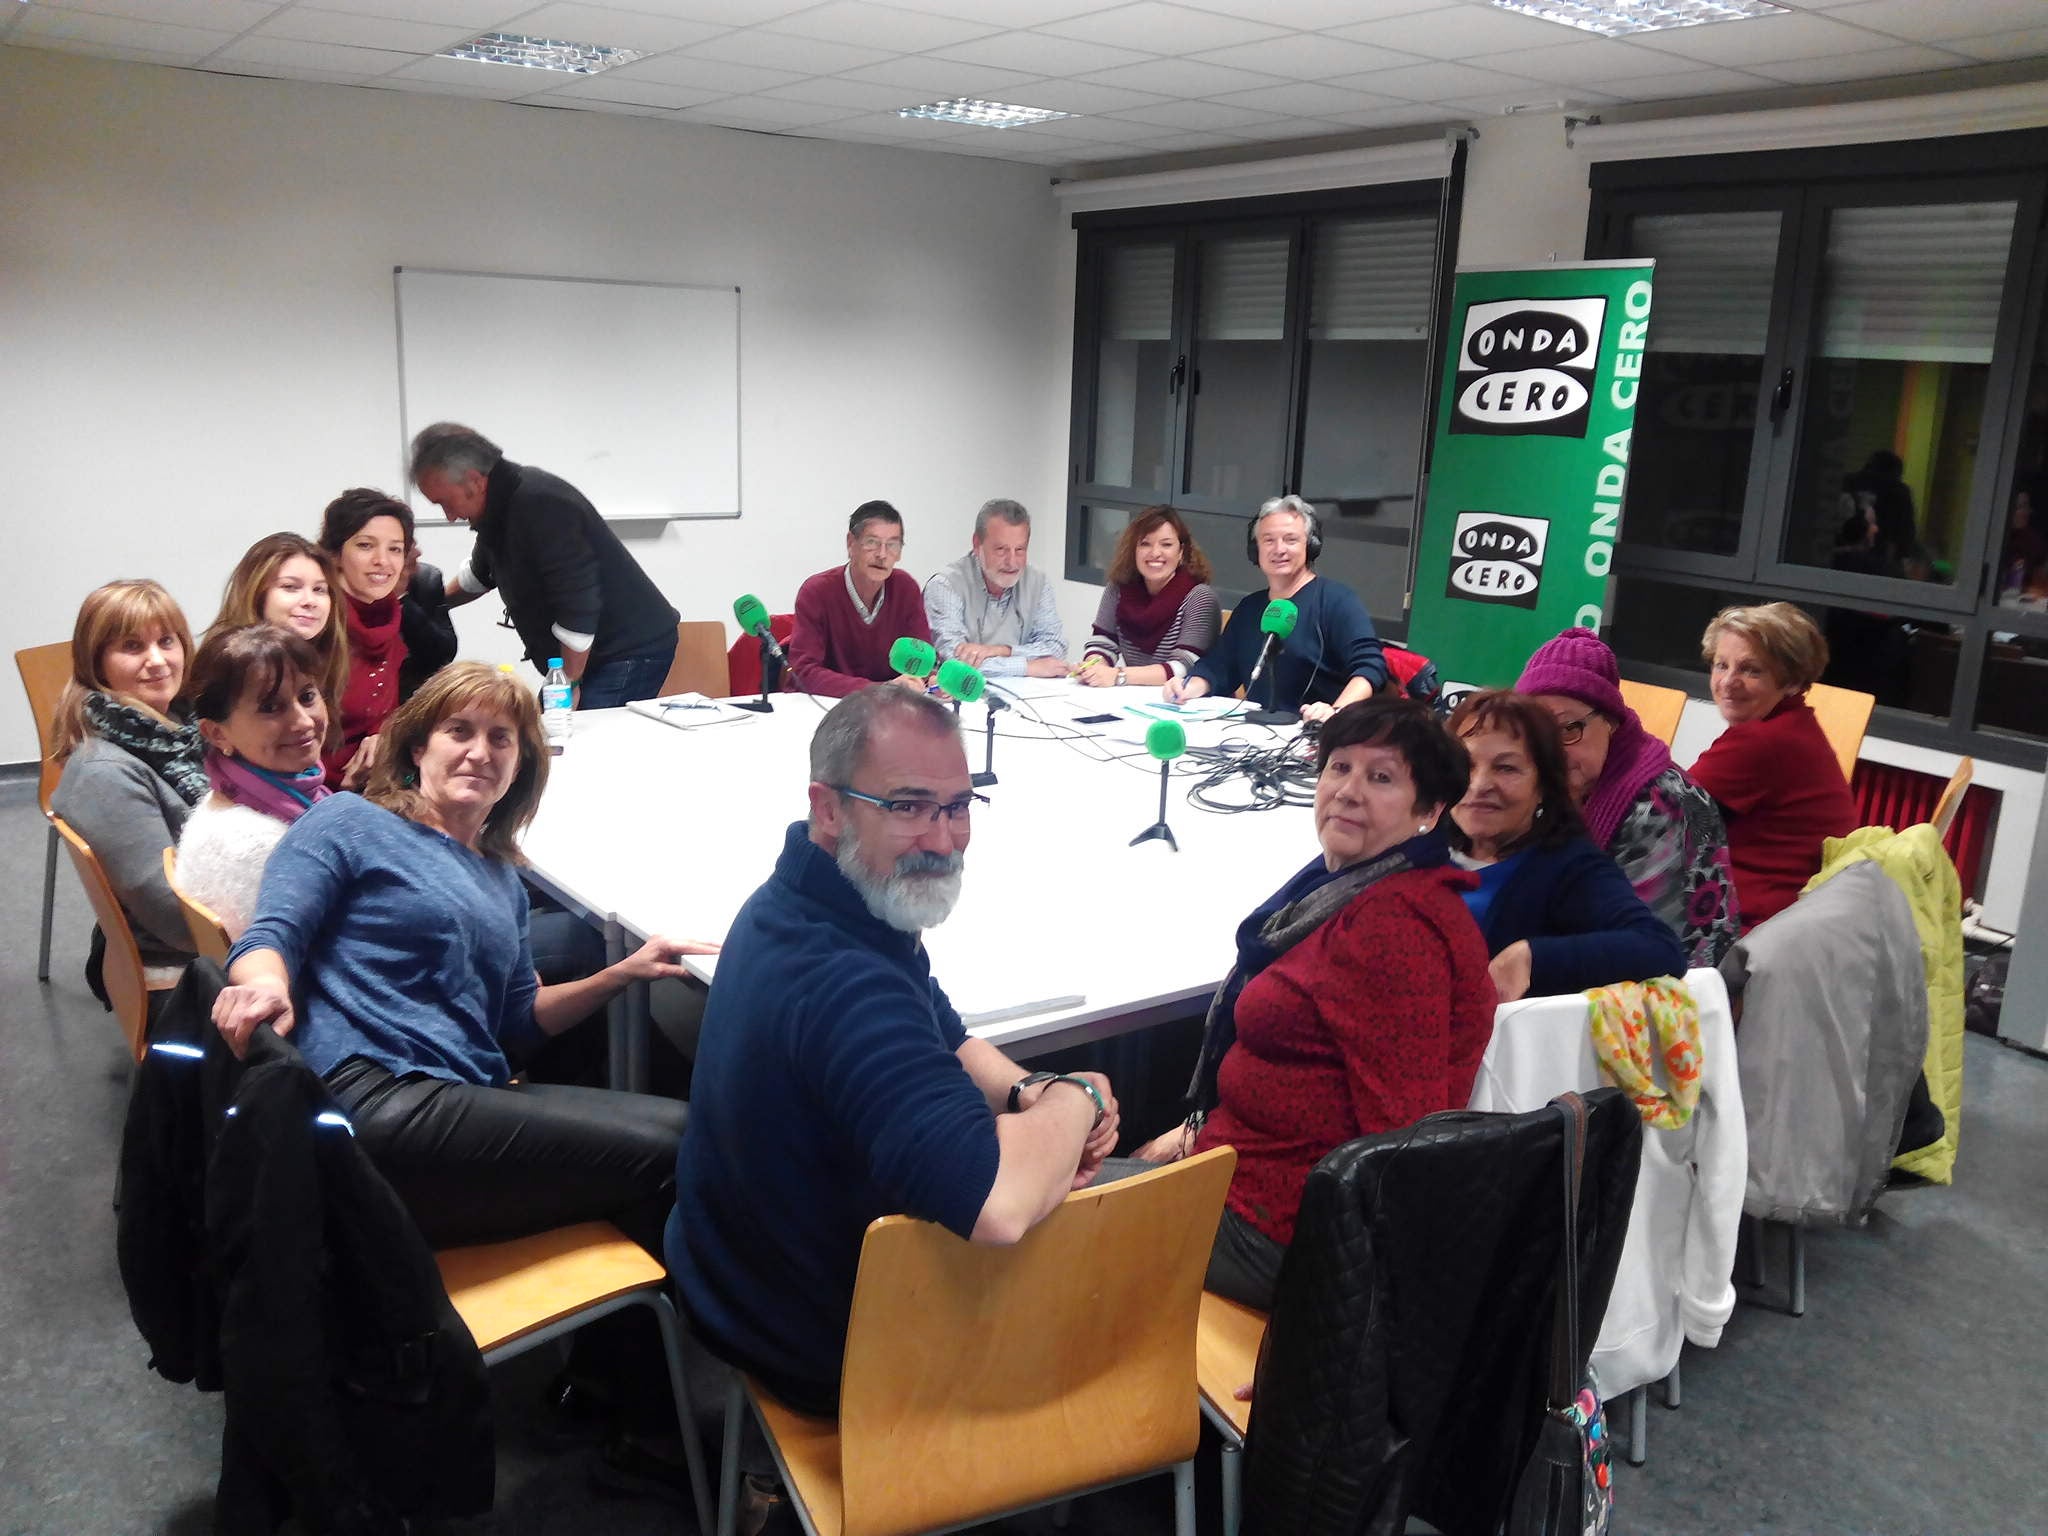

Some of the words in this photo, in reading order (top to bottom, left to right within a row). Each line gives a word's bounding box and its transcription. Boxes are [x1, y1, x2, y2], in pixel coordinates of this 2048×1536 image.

[1477, 327, 1577, 356] ONDA
[1476, 380, 1570, 411] CERO
[1584, 427, 1633, 577] ONDA
[1611, 280, 1653, 410] CERO
[1464, 529, 1531, 555] ONDA
[1464, 565, 1526, 590] CERO
